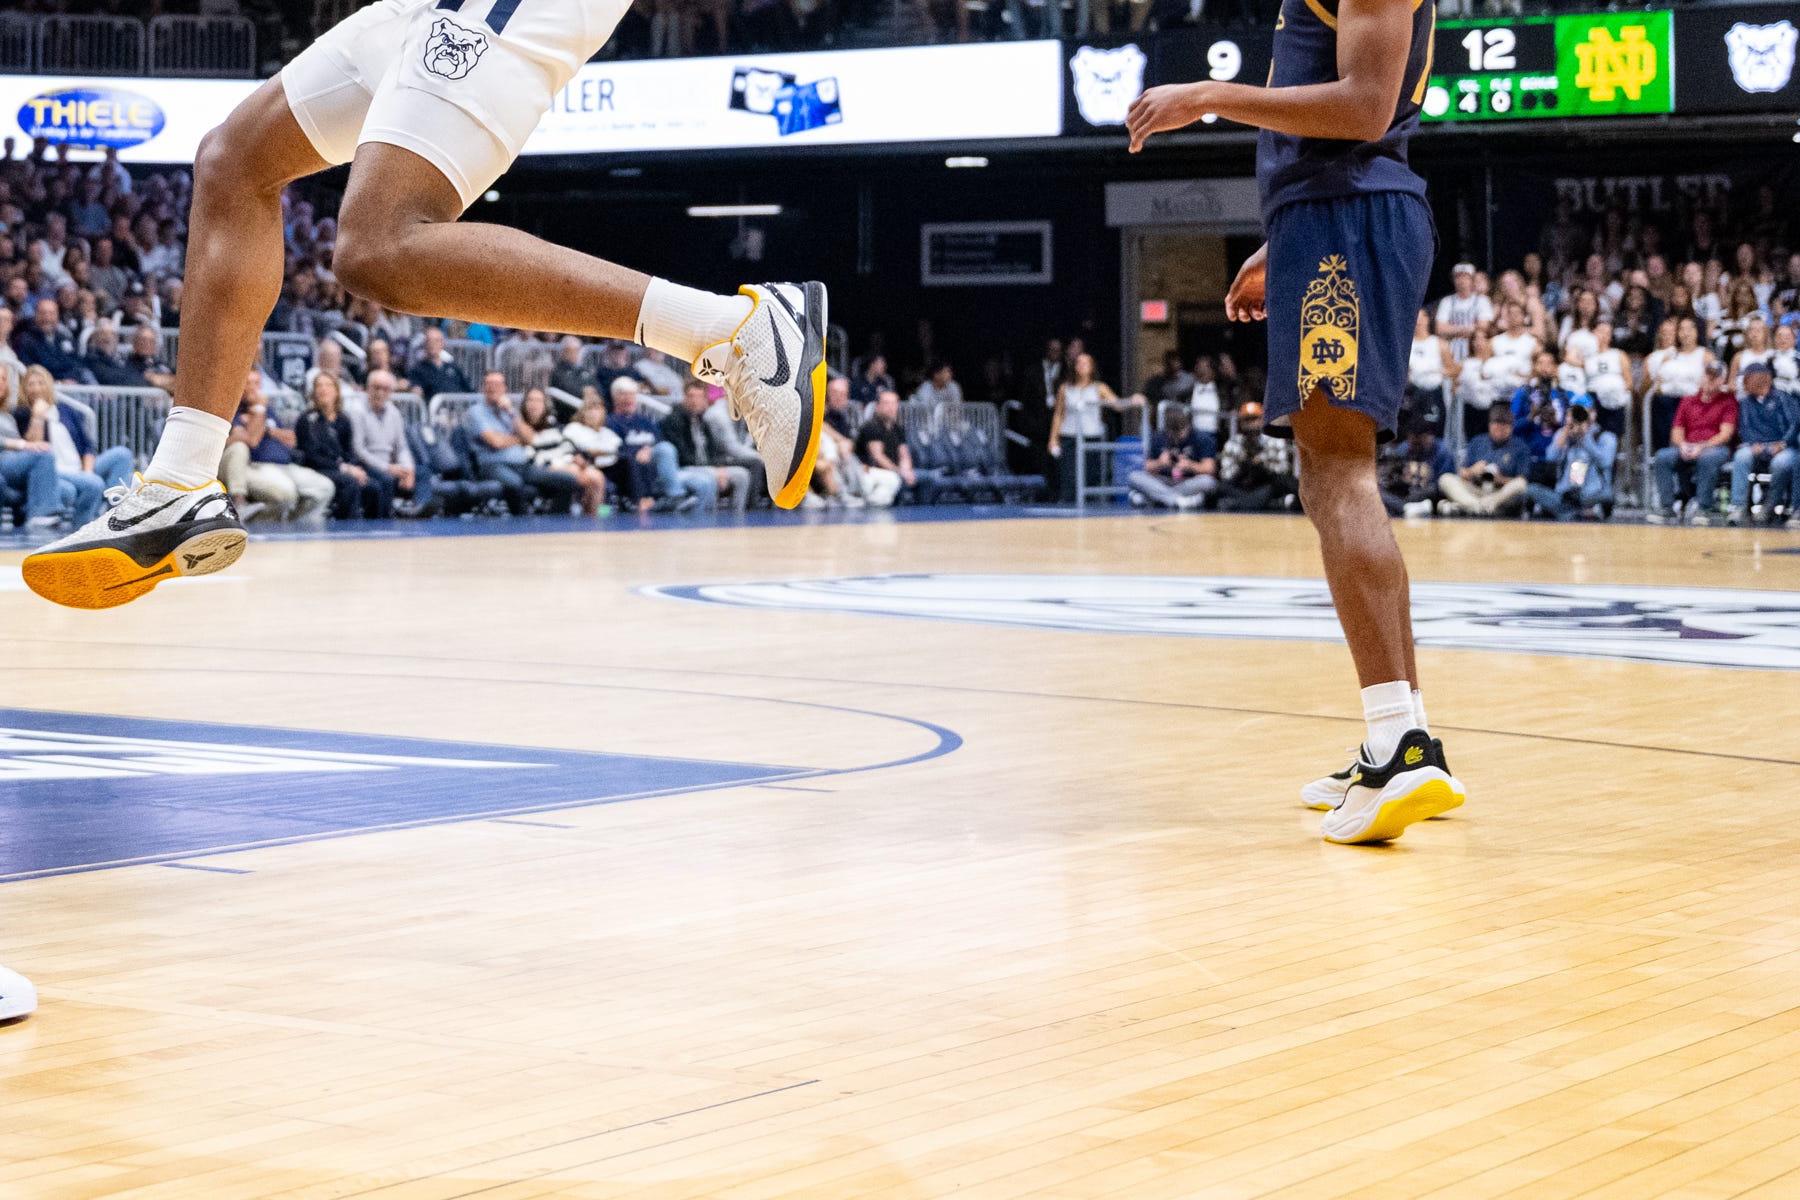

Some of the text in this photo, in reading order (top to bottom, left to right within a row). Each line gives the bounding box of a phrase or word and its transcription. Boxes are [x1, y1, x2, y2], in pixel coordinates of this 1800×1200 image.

[1206, 39, 1242, 82] 9
[1461, 28, 1517, 71] 12
[550, 78, 615, 113] LER
[1458, 92, 1477, 113] 4
[28, 98, 154, 129] THIELE
[1312, 337, 1345, 365] ND
